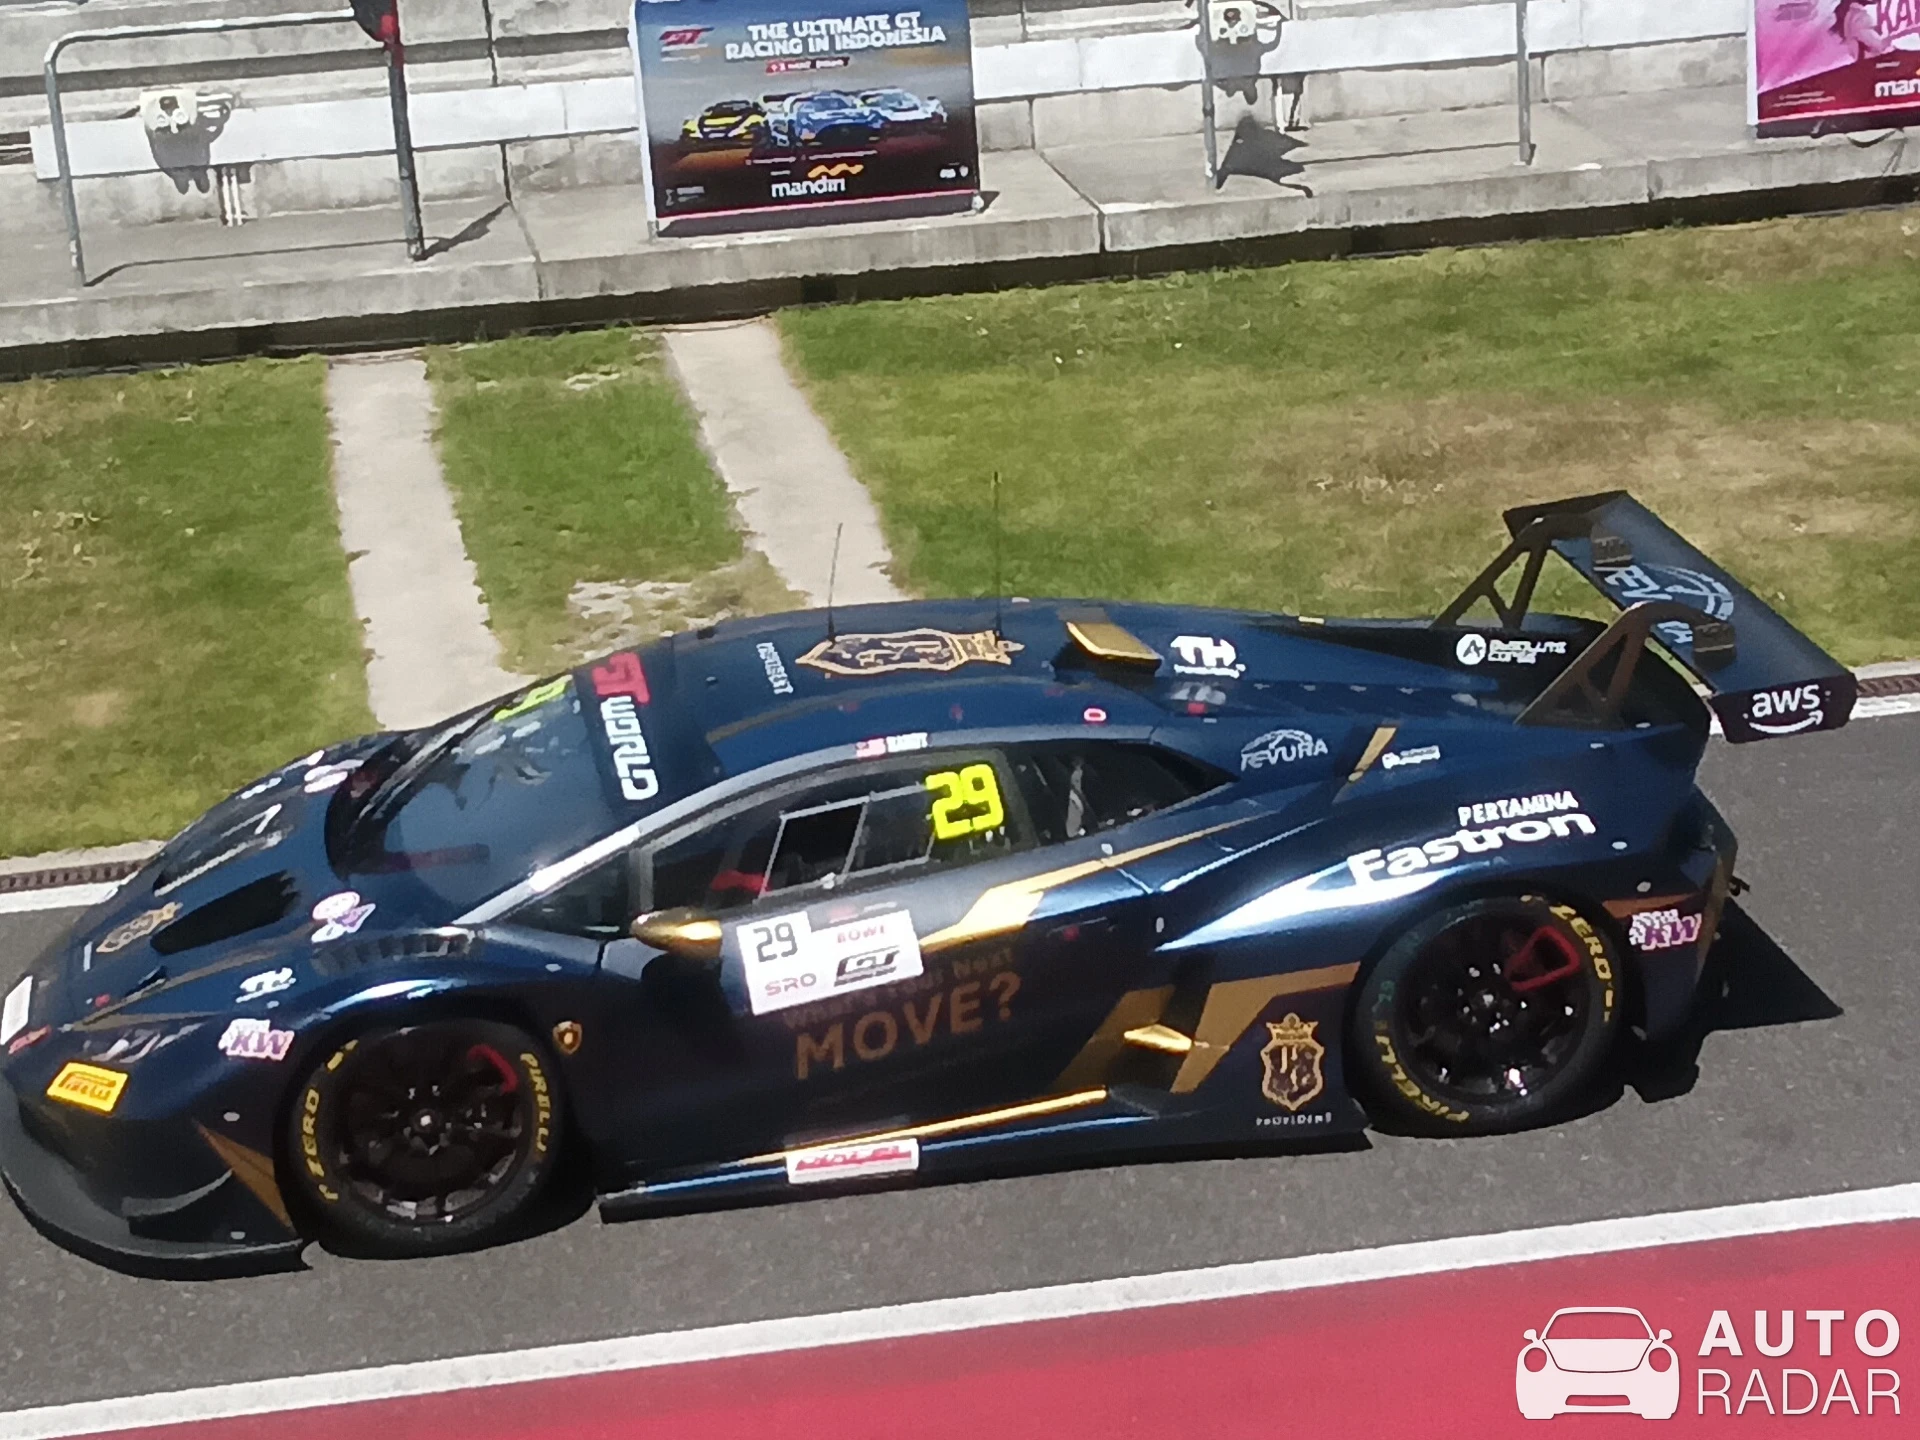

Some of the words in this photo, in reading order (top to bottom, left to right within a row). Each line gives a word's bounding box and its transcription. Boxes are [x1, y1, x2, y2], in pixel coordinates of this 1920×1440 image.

[725, 38, 802, 61] RACING
[808, 34, 830, 53] IN
[835, 25, 947, 50] INDONESIA
[748, 22, 788, 41] THE
[793, 14, 890, 37] ULTIMATE
[895, 11, 921, 29] GT
[771, 175, 846, 198] mandiri
[1752, 684, 1821, 719] aws
[600, 696, 659, 801] WORLD
[925, 763, 1005, 840] 29
[1457, 790, 1579, 827] PERTAMINA
[1347, 812, 1597, 886] Fastron
[752, 922, 798, 963] 29
[1549, 903, 1612, 980] ZERO
[764, 973, 817, 997] SRO
[794, 970, 1022, 1081] MOVE?
